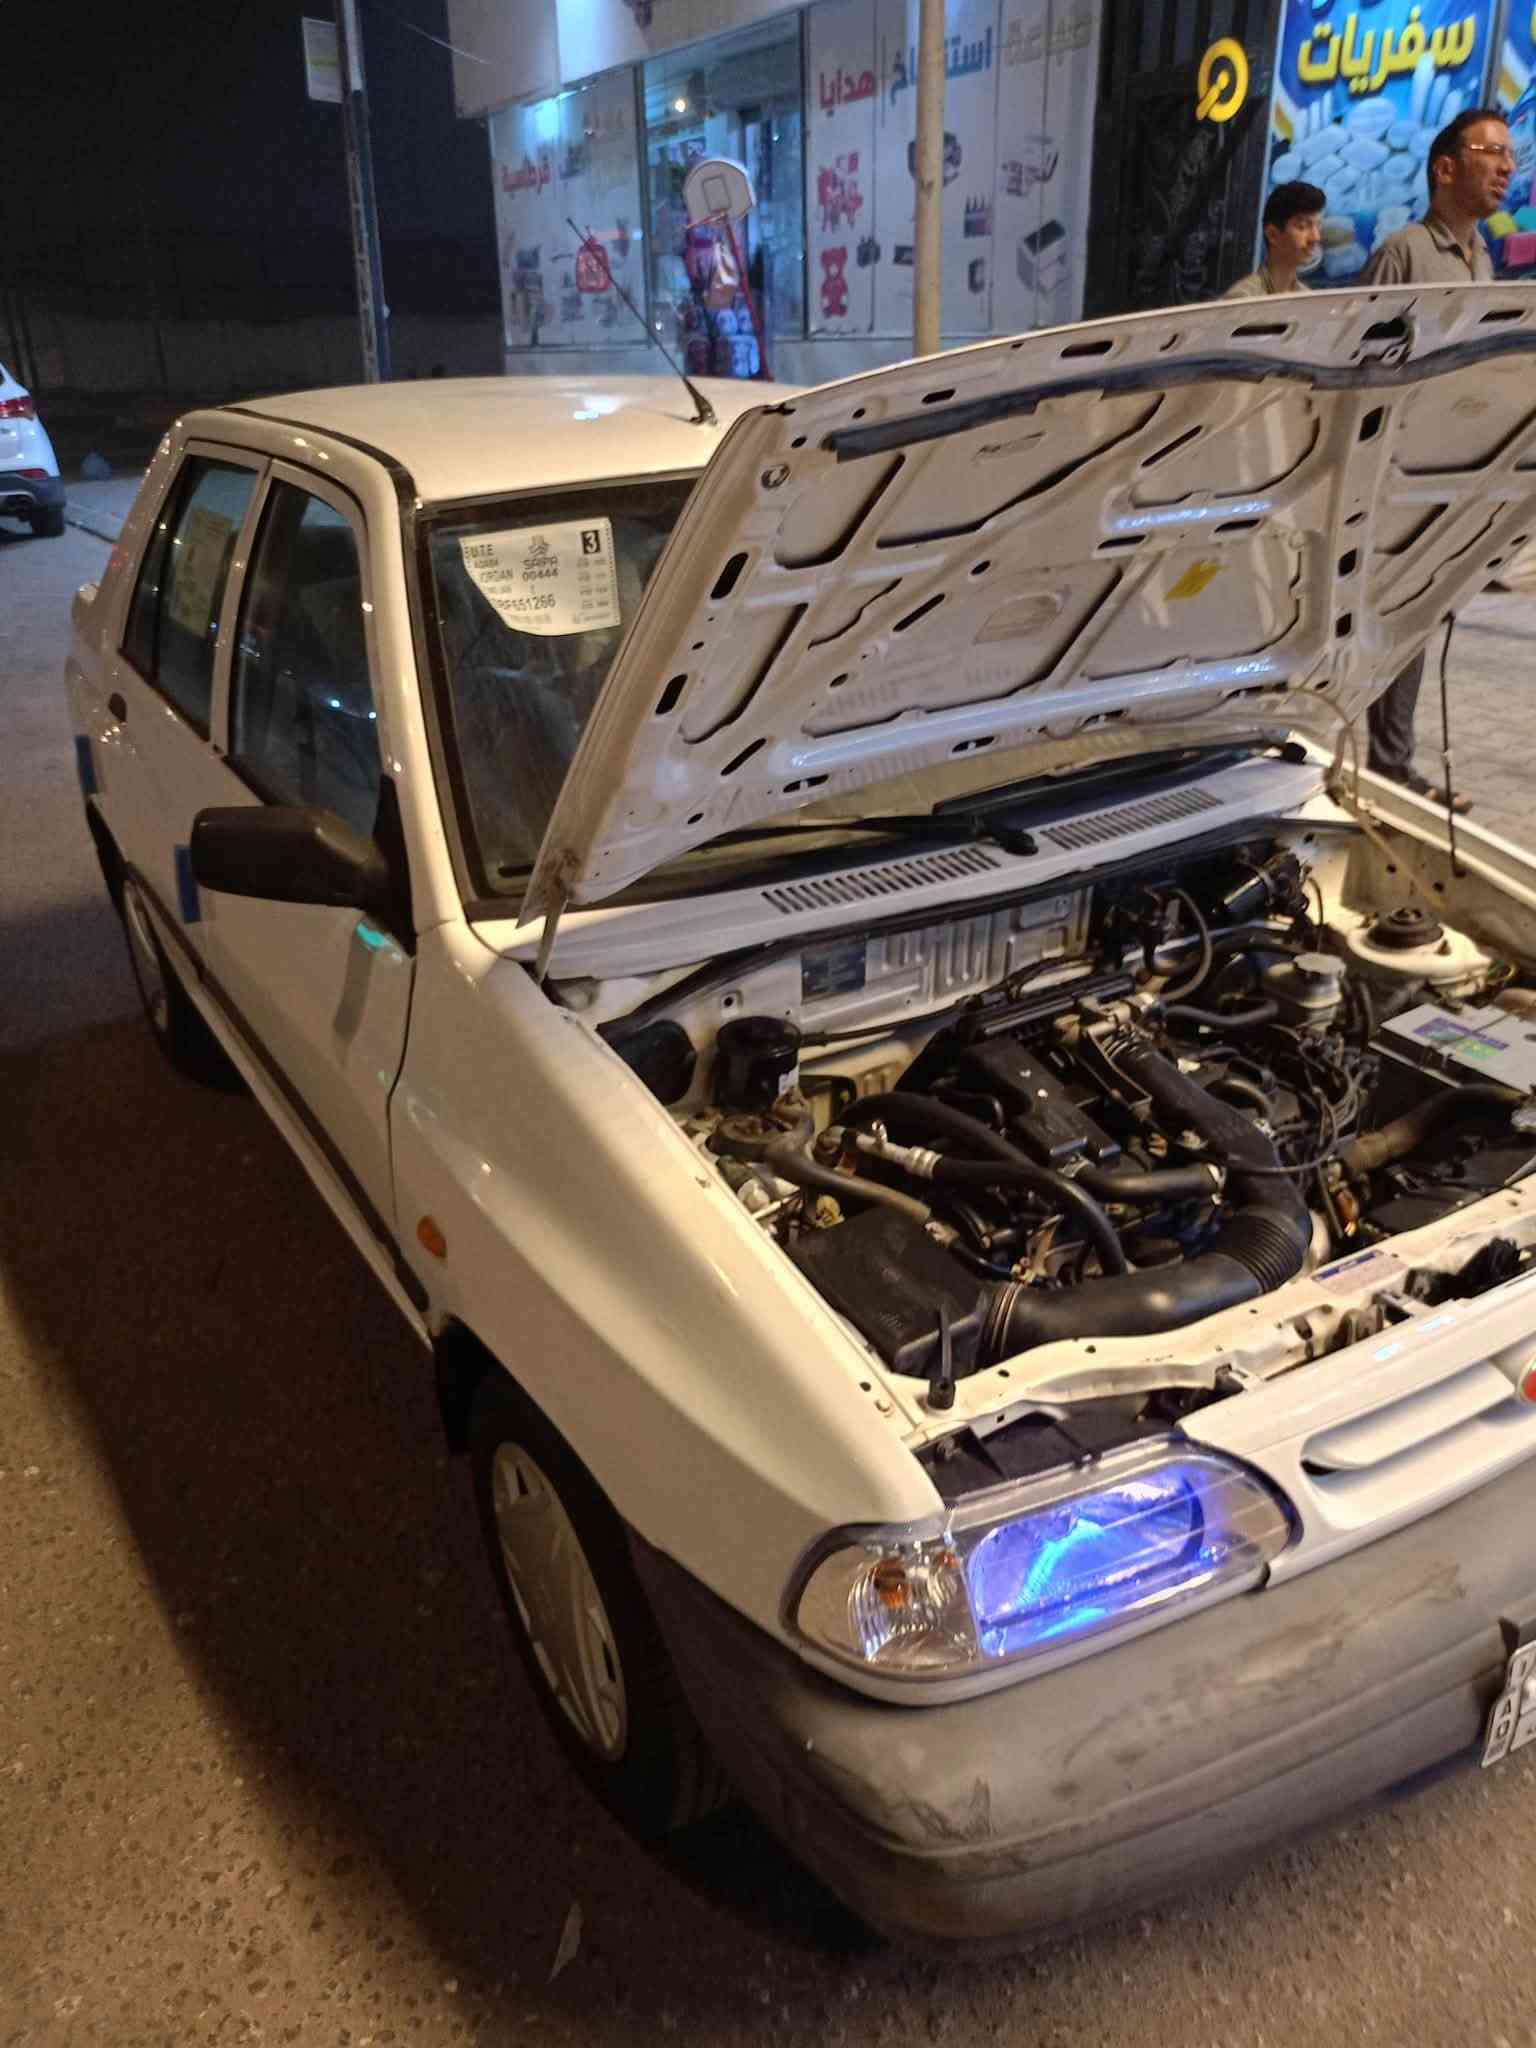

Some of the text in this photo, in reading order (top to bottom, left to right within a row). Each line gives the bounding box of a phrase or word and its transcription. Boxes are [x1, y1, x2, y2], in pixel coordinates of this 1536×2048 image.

[889, 25, 992, 107] استاخ
[1297, 7, 1476, 94] سفريات
[820, 68, 877, 118] هدايا
[583, 531, 599, 554] 3
